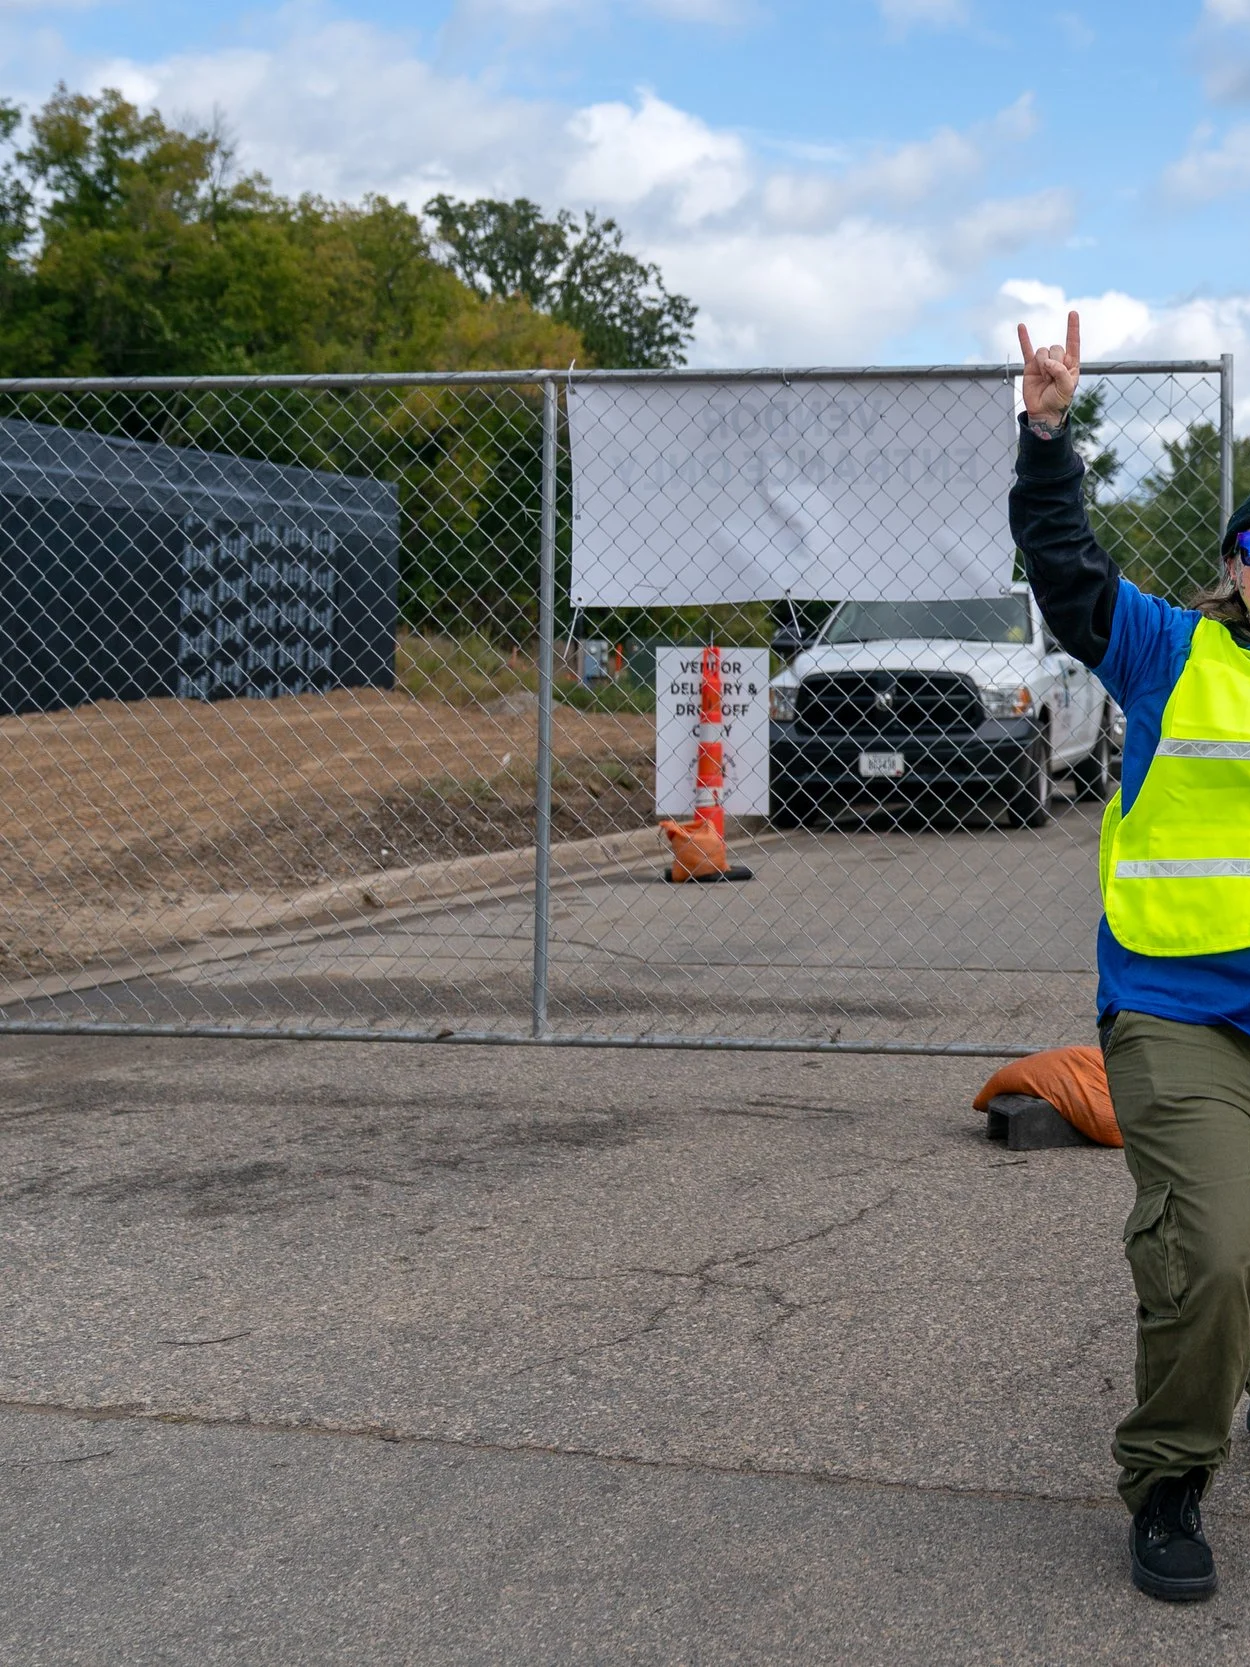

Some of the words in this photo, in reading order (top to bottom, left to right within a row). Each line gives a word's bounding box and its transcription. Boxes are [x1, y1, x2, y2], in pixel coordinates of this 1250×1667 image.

[671, 682, 742, 695] DELIRY
[748, 683, 758, 695] &
[675, 704, 715, 717] DR
[721, 704, 750, 717] OFF
[692, 724, 732, 737] OY
